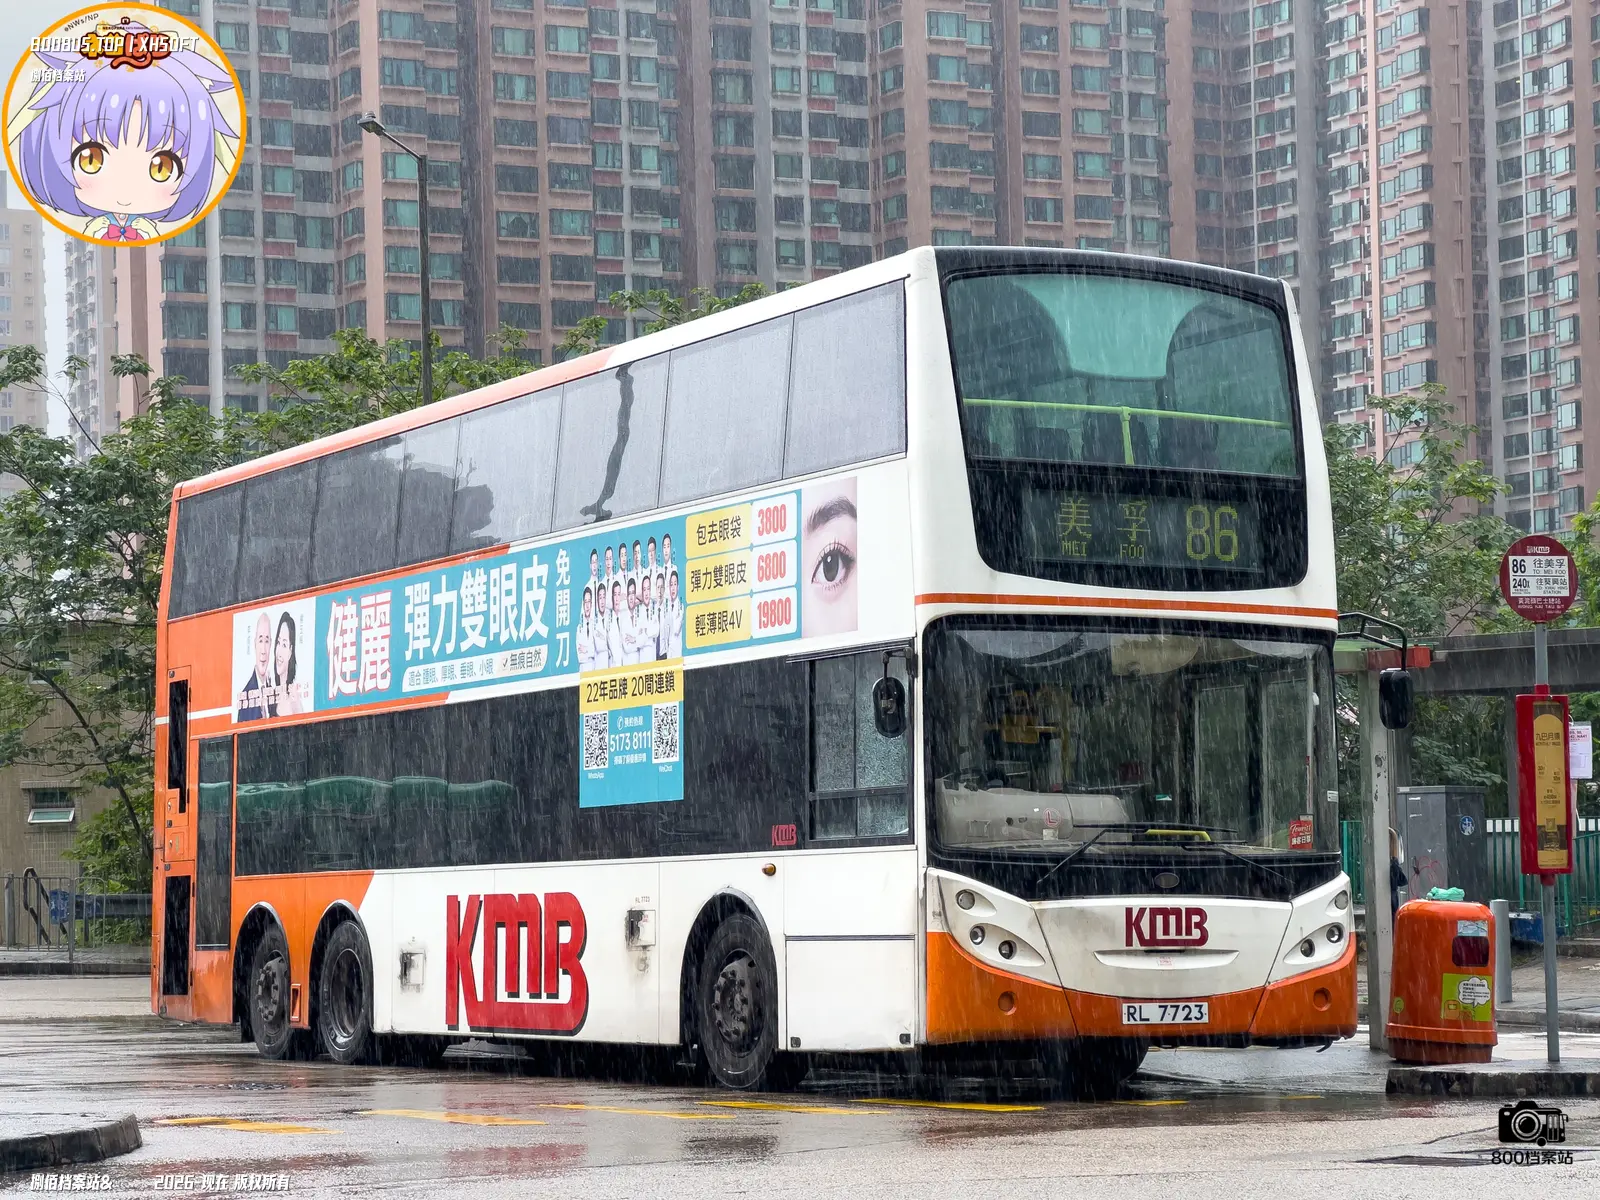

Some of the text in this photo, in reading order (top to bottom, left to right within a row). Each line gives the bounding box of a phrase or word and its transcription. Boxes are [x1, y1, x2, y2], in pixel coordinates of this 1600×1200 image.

[696, 515, 742, 546] 包去眼袋
[757, 504, 787, 537] 3800
[1186, 504, 1239, 561] 86
[1061, 540, 1087, 557] MEI
[1533, 558, 1565, 569] 往美孚
[690, 560, 747, 593] 彈力雙眼皮
[757, 550, 787, 583] 6800
[1511, 559, 1526, 574] 86
[404, 554, 549, 661] 彈力雙眼皮
[555, 548, 571, 668] 免開刀
[695, 609, 743, 638] 輕薄眼4V
[757, 596, 791, 629] 19800
[326, 589, 392, 699] 健麗
[510, 650, 542, 672] 無痕自然
[587, 670, 675, 703] 22年品牌 20間連鎖
[610, 730, 651, 752] 5173 8111
[772, 824, 797, 846] KMB
[1125, 907, 1209, 947] KMB
[445, 891, 589, 1036] KMB
[1127, 1004, 1204, 1022] RL 7723
